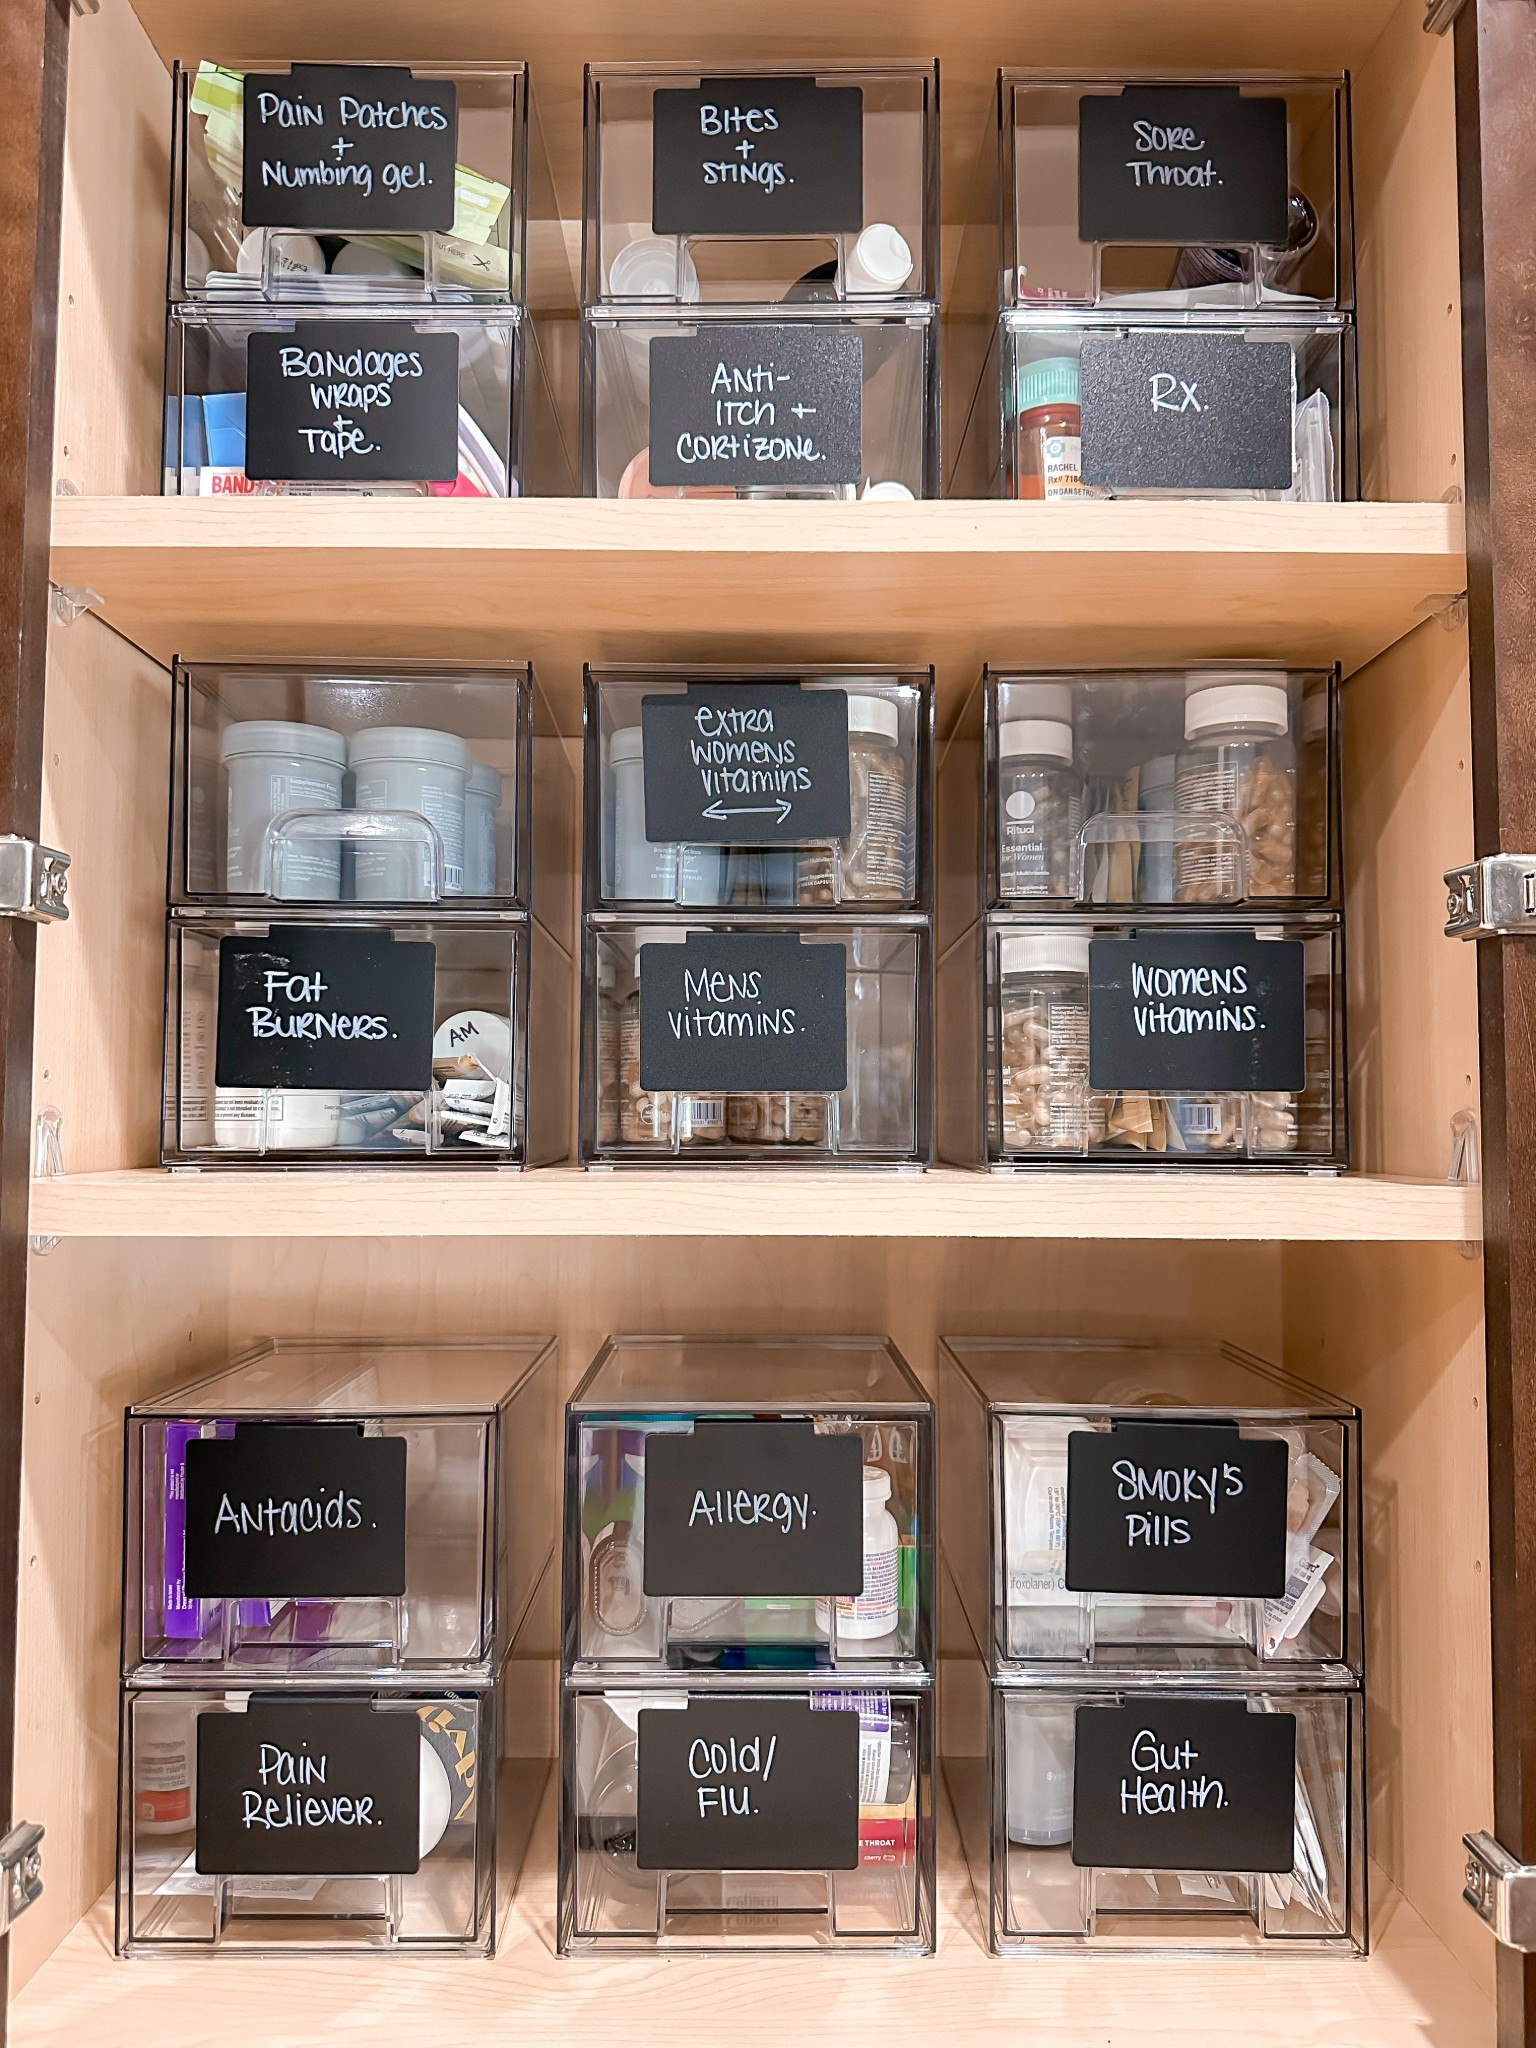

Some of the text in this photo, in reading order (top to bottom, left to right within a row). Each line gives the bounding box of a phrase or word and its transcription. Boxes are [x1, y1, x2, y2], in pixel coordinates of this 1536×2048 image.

[258, 93, 447, 130] Pain Patches
[1134, 121, 1204, 151] Sore
[262, 157, 432, 196] Numbing gel.
[1126, 160, 1222, 186] Throat.
[711, 362, 793, 394] Anti-
[1148, 372, 1209, 413] Rx.
[298, 425, 380, 458] Tape.
[1047, 463, 1079, 473] RACHEL
[695, 707, 773, 737] extra
[701, 762, 811, 796] vitamins
[1007, 825, 1034, 835] Ritual
[1001, 843, 1042, 853] Essential
[1014, 852, 1044, 861] Women
[264, 971, 328, 1002] Fat
[684, 967, 762, 1000] Mens
[451, 1022, 479, 1047] AM
[668, 998, 805, 1039] vitamins.
[1134, 1001, 1265, 1036] vitamins.
[689, 1490, 816, 1533] Allergy.
[1126, 1512, 1190, 1546] Pills
[259, 1743, 325, 1785] Pain
[689, 1736, 776, 1781] Cold/
[1132, 1730, 1198, 1773] Gut
[242, 1791, 381, 1829] Reliever.
[697, 1785, 758, 1817] Flu.
[1121, 1776, 1228, 1814] Health.
[865, 1839, 896, 1847] THROAT
